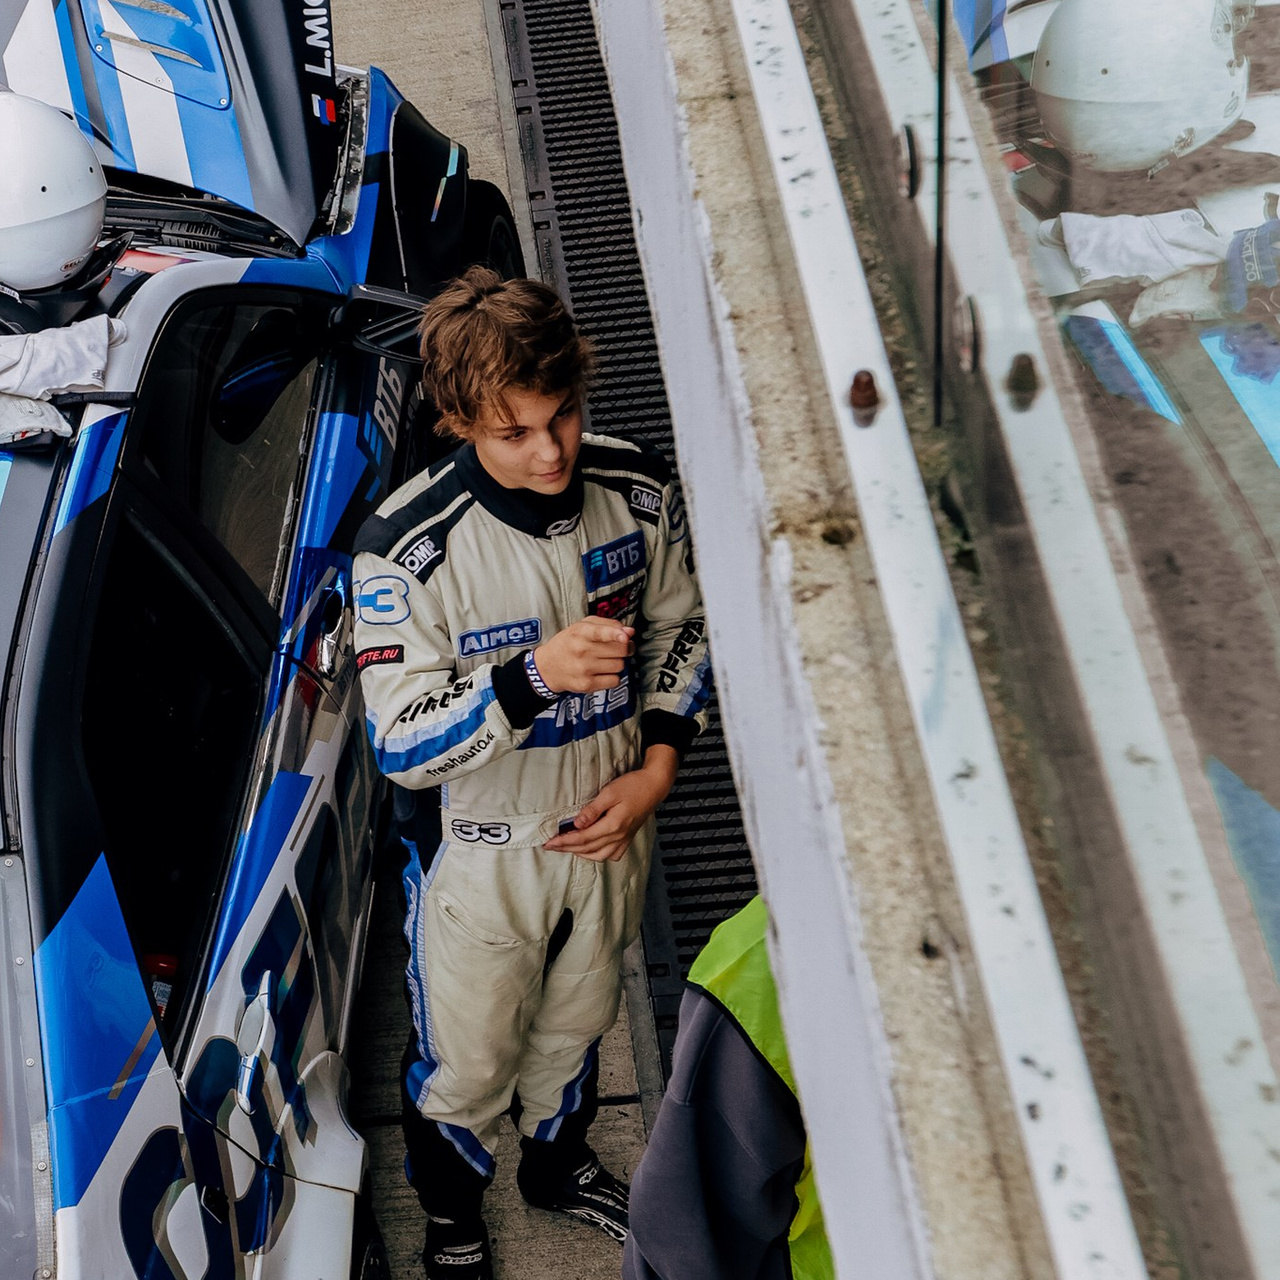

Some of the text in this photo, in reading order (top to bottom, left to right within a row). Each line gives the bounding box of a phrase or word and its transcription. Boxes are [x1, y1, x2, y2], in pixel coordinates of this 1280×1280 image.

[62, 257, 84, 270] BELL
[374, 357, 404, 451] ВТБ
[631, 489, 662, 511] OMP
[403, 539, 437, 573] OMP
[605, 541, 640, 574] ВТБ
[463, 623, 535, 652] AIMOL
[452, 819, 511, 845] 33
